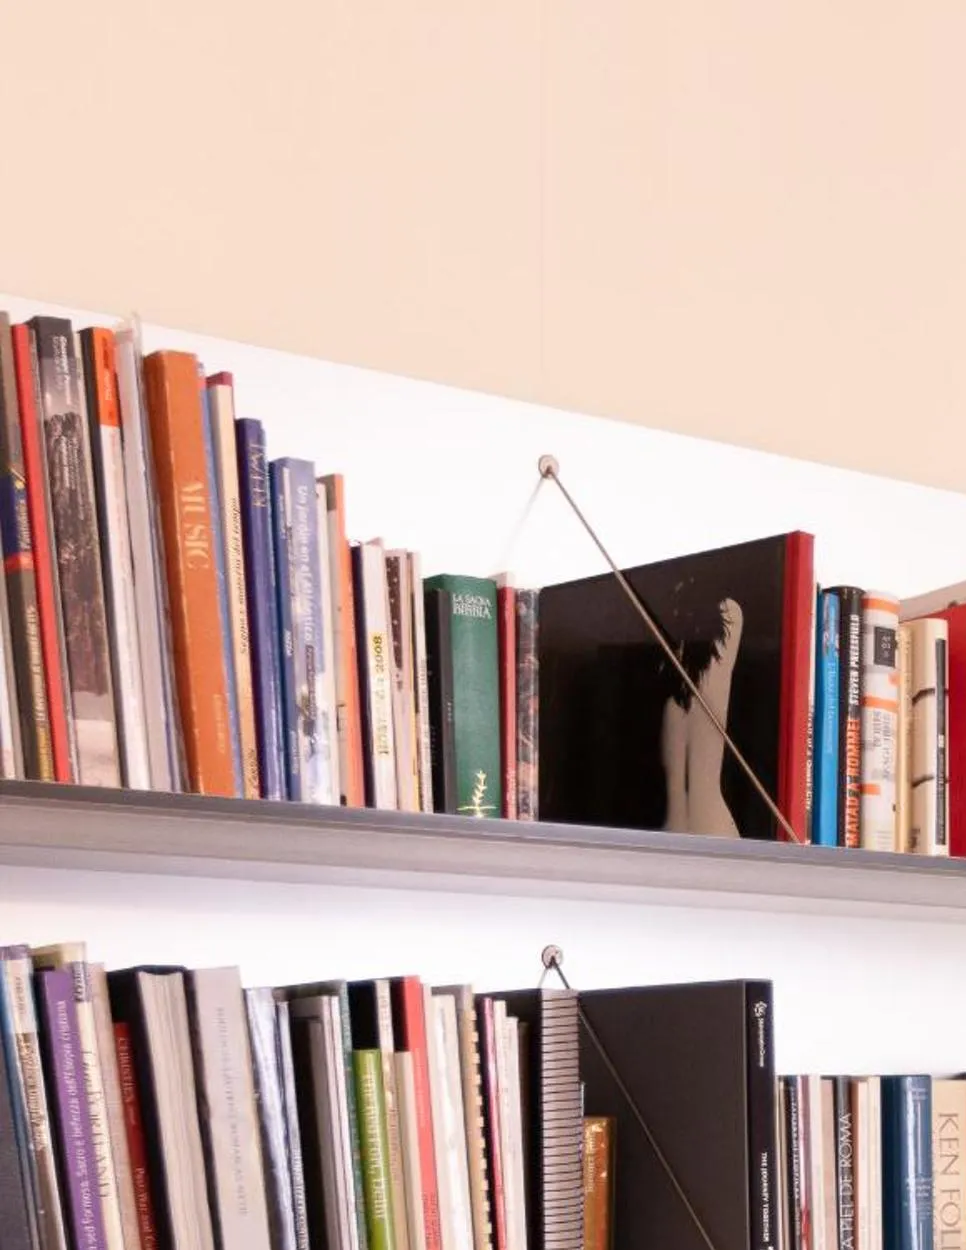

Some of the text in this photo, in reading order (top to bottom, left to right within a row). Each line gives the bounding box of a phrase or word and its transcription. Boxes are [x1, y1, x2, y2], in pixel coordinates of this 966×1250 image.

[180, 480, 212, 570] MUSIC
[837, 1112, 854, 1166] ROMA
[938, 1112, 961, 1175] KEN
[838, 1174, 854, 1194] DE
